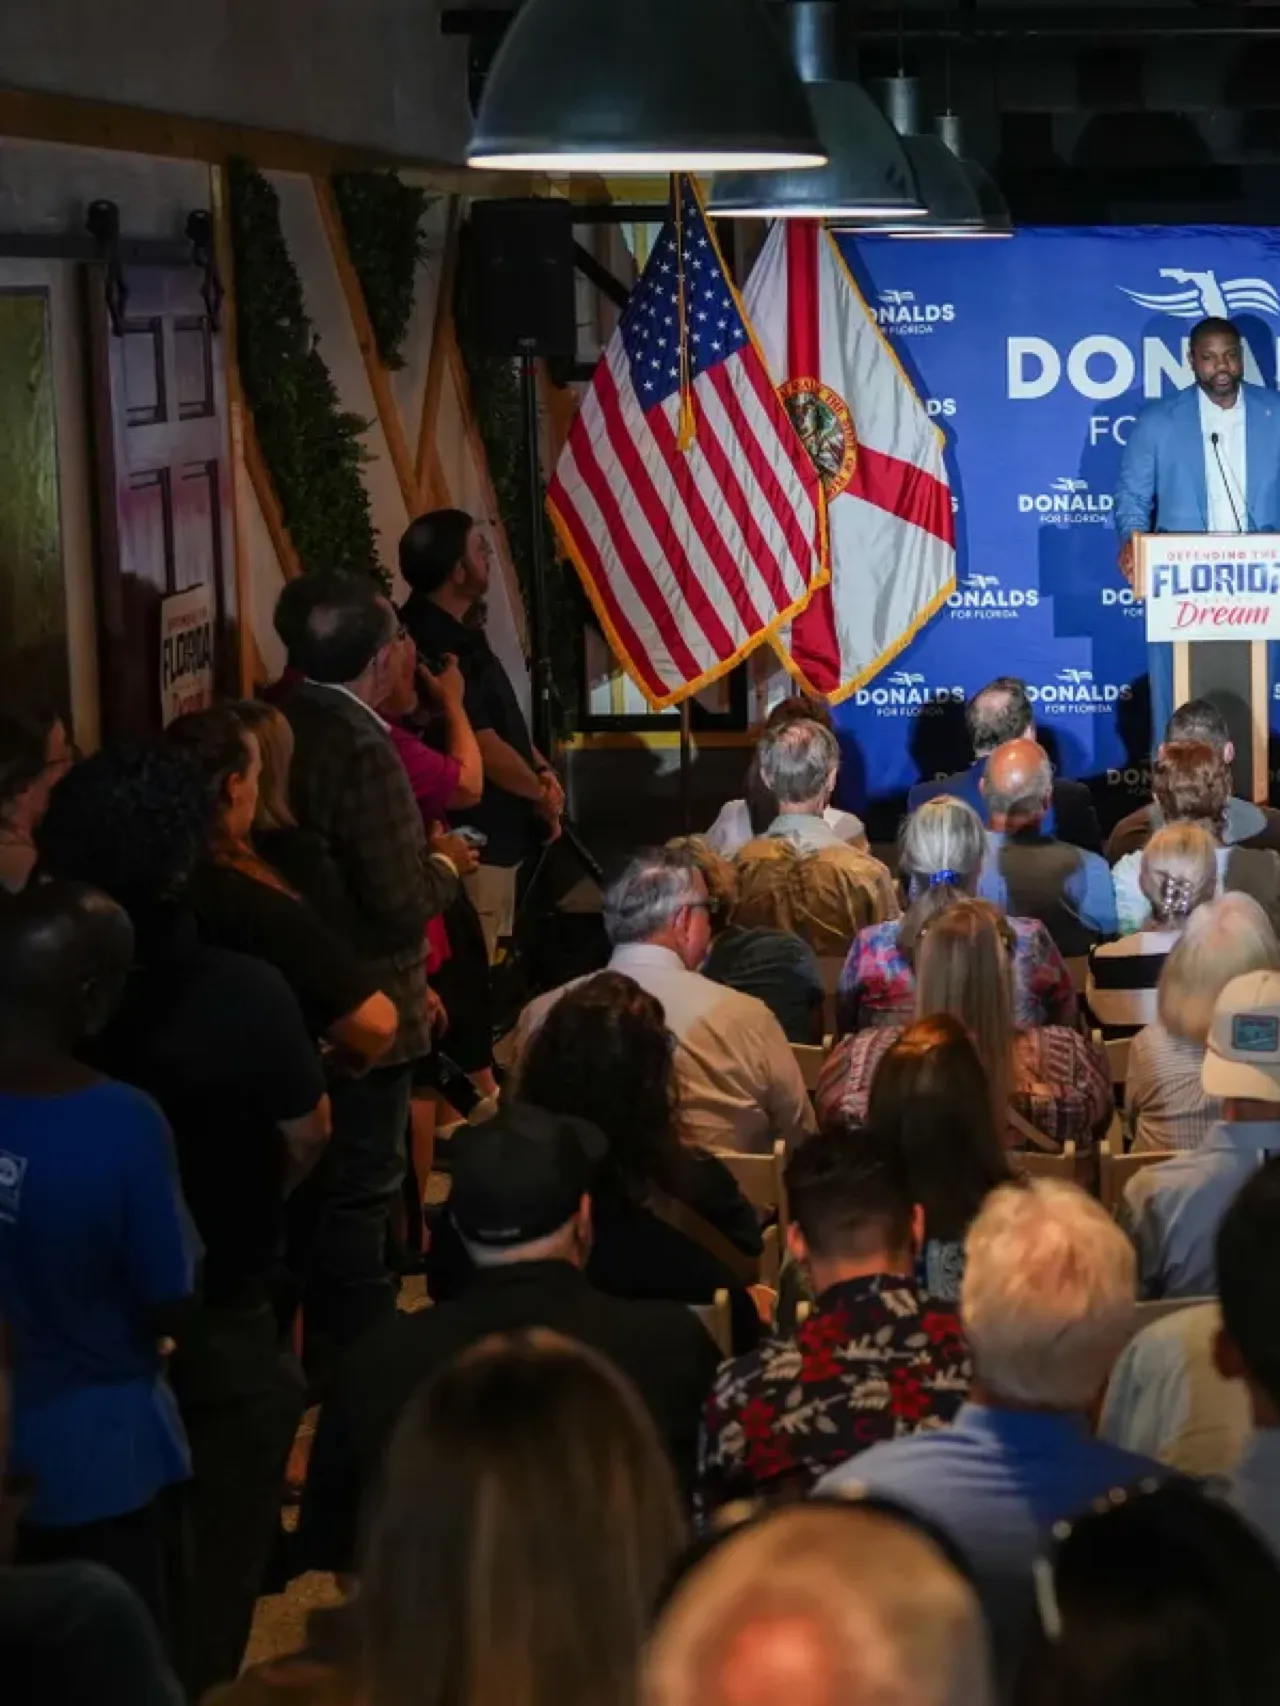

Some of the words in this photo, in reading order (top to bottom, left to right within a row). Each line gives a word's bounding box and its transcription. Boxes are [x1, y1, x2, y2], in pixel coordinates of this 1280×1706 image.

[1018, 493, 1114, 512] DONALD
[1064, 513, 1107, 523] FLORIDA
[1166, 550, 1247, 561] DEFENDING
[1253, 550, 1278, 559] THE
[947, 589, 1040, 608] ONALDS
[951, 610, 972, 619] FOR
[975, 609, 1019, 619] FLORIDA
[1169, 600, 1270, 630] Dream
[855, 686, 965, 706] DONALDS
[1024, 683, 1134, 702] DONALDS
[1044, 705, 1065, 714] FOR
[1068, 703, 1112, 714] FLORIDA
